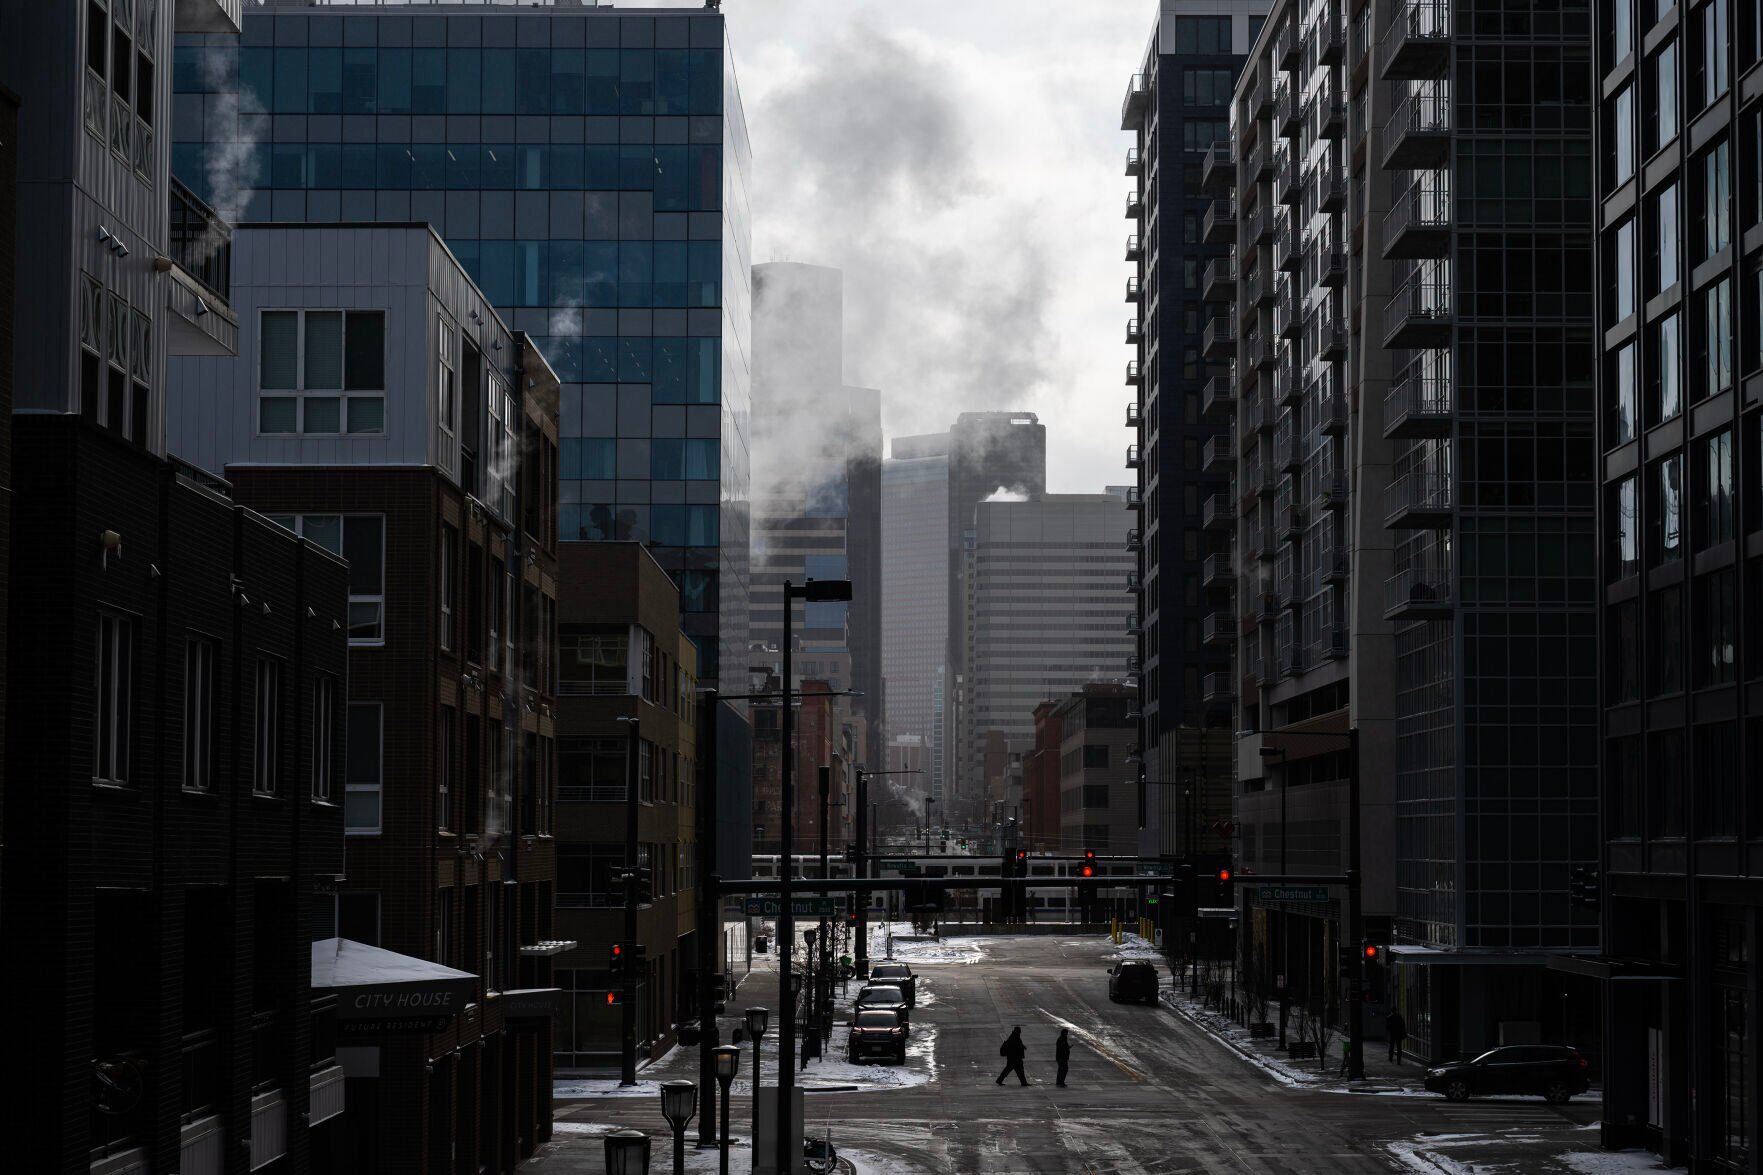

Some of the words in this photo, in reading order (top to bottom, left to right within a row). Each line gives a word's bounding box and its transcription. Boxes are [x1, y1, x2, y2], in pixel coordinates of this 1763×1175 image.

[1274, 888, 1312, 900] Chestnut
[764, 900, 813, 914] Chetnut
[354, 991, 394, 1009] CITY
[396, 991, 453, 1008] HOUSE
